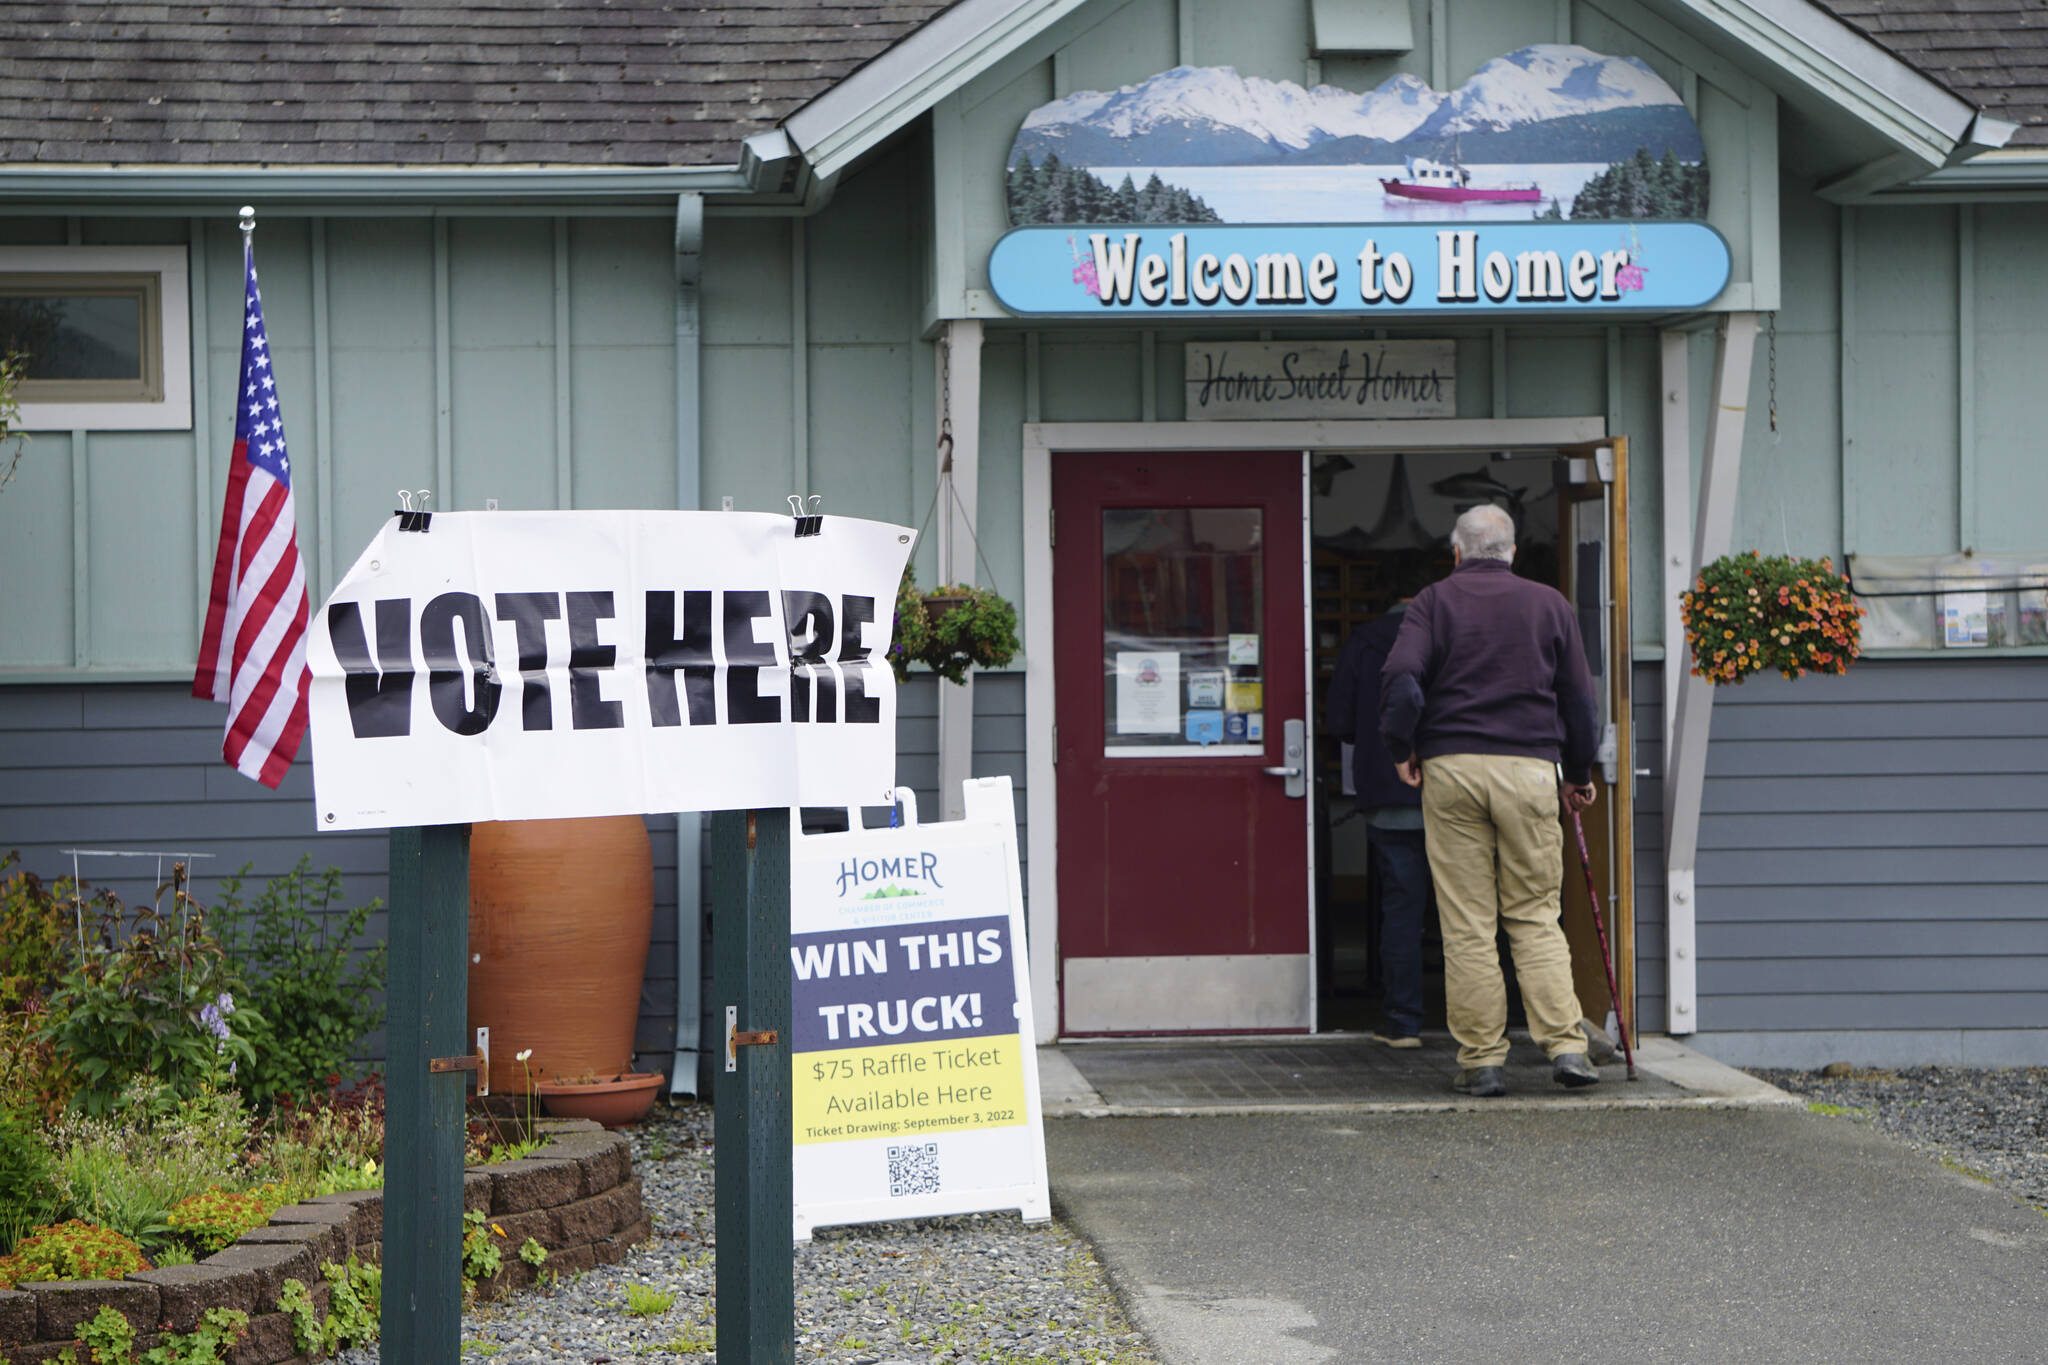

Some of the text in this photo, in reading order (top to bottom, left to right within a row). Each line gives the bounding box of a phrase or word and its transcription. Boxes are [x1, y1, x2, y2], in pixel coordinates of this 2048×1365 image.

[1089, 230, 1629, 304] Welcome to Homer
[1199, 349, 1443, 407] Home Sweet Homer
[328, 589, 881, 738] VOTE HERE
[836, 852, 944, 897] HOMER
[791, 929, 1002, 980] WIN THIS
[818, 993, 983, 1040] TRUCK!
[813, 1048, 1002, 1081] $75 Raffle Ticket
[826, 1085, 992, 1115] Available Here
[806, 1110, 1015, 1138] Ticket Drawing: September 3, 2022
